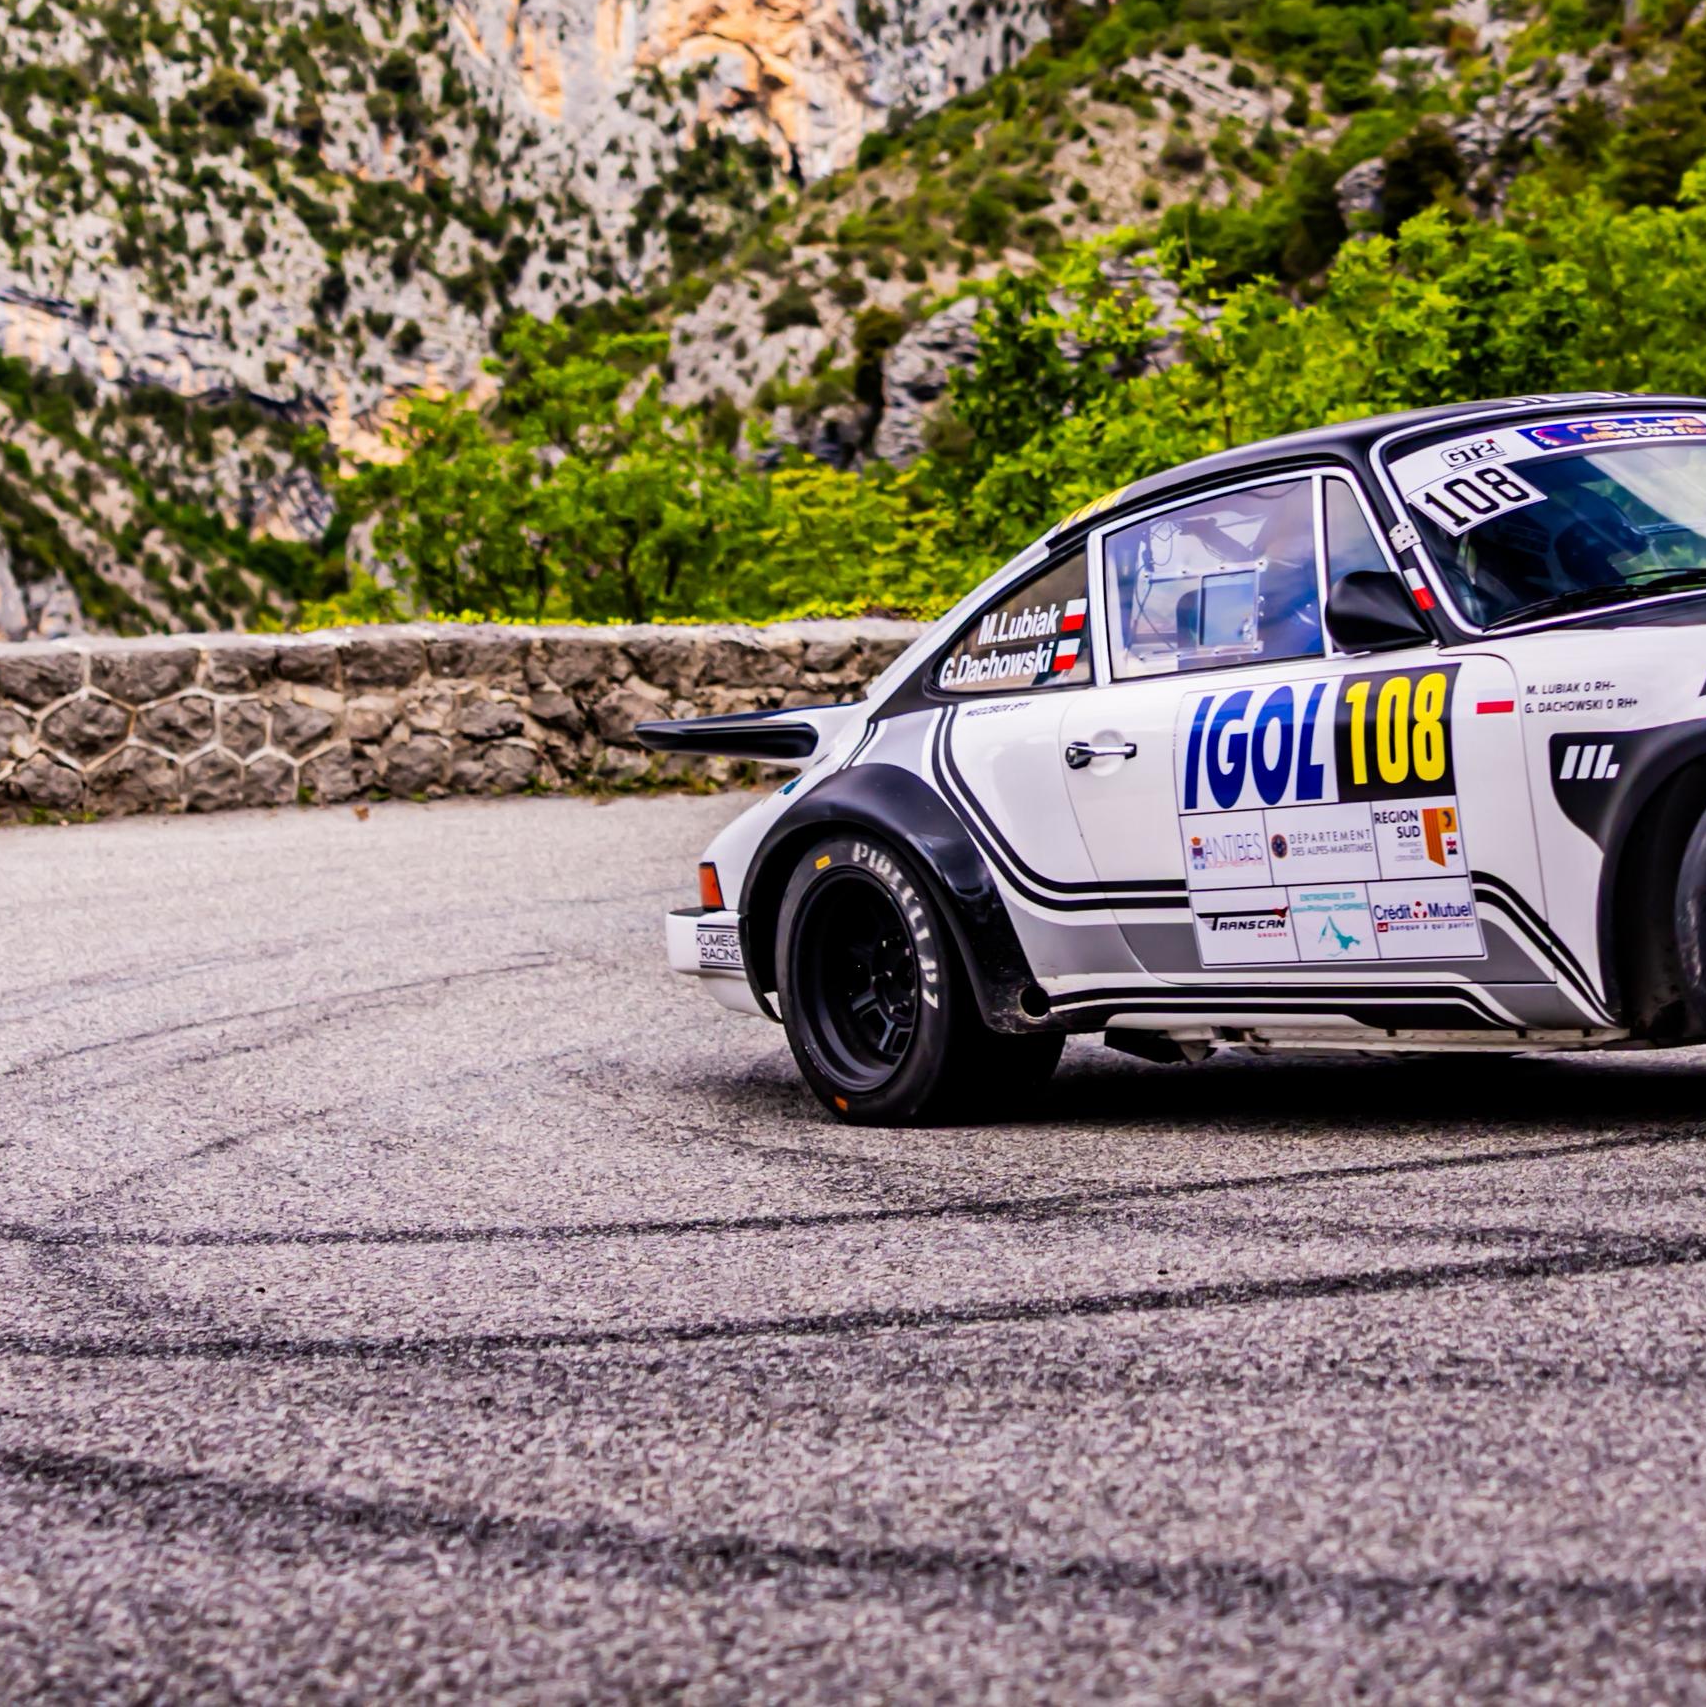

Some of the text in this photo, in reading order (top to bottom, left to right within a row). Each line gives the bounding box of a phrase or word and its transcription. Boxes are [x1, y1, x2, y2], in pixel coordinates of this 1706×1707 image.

[1425, 467, 1530, 528] 108
[978, 603, 1061, 646] M.Lubiak
[939, 641, 1055, 689] G.Dachowski
[1526, 685, 1538, 695] M.
[1542, 683, 1580, 694] LUBIAK
[1524, 702, 1534, 714] G.
[1538, 699, 1603, 713] DACHOWSKI
[1184, 672, 1447, 810] IGOL 108
[1396, 825, 1421, 839] SUD
[1204, 832, 1263, 862] ANTIBES
[1292, 847, 1305, 856] DES
[1373, 903, 1412, 920] Crédit
[1428, 901, 1473, 917] Mutuel
[701, 947, 740, 962] RACING
